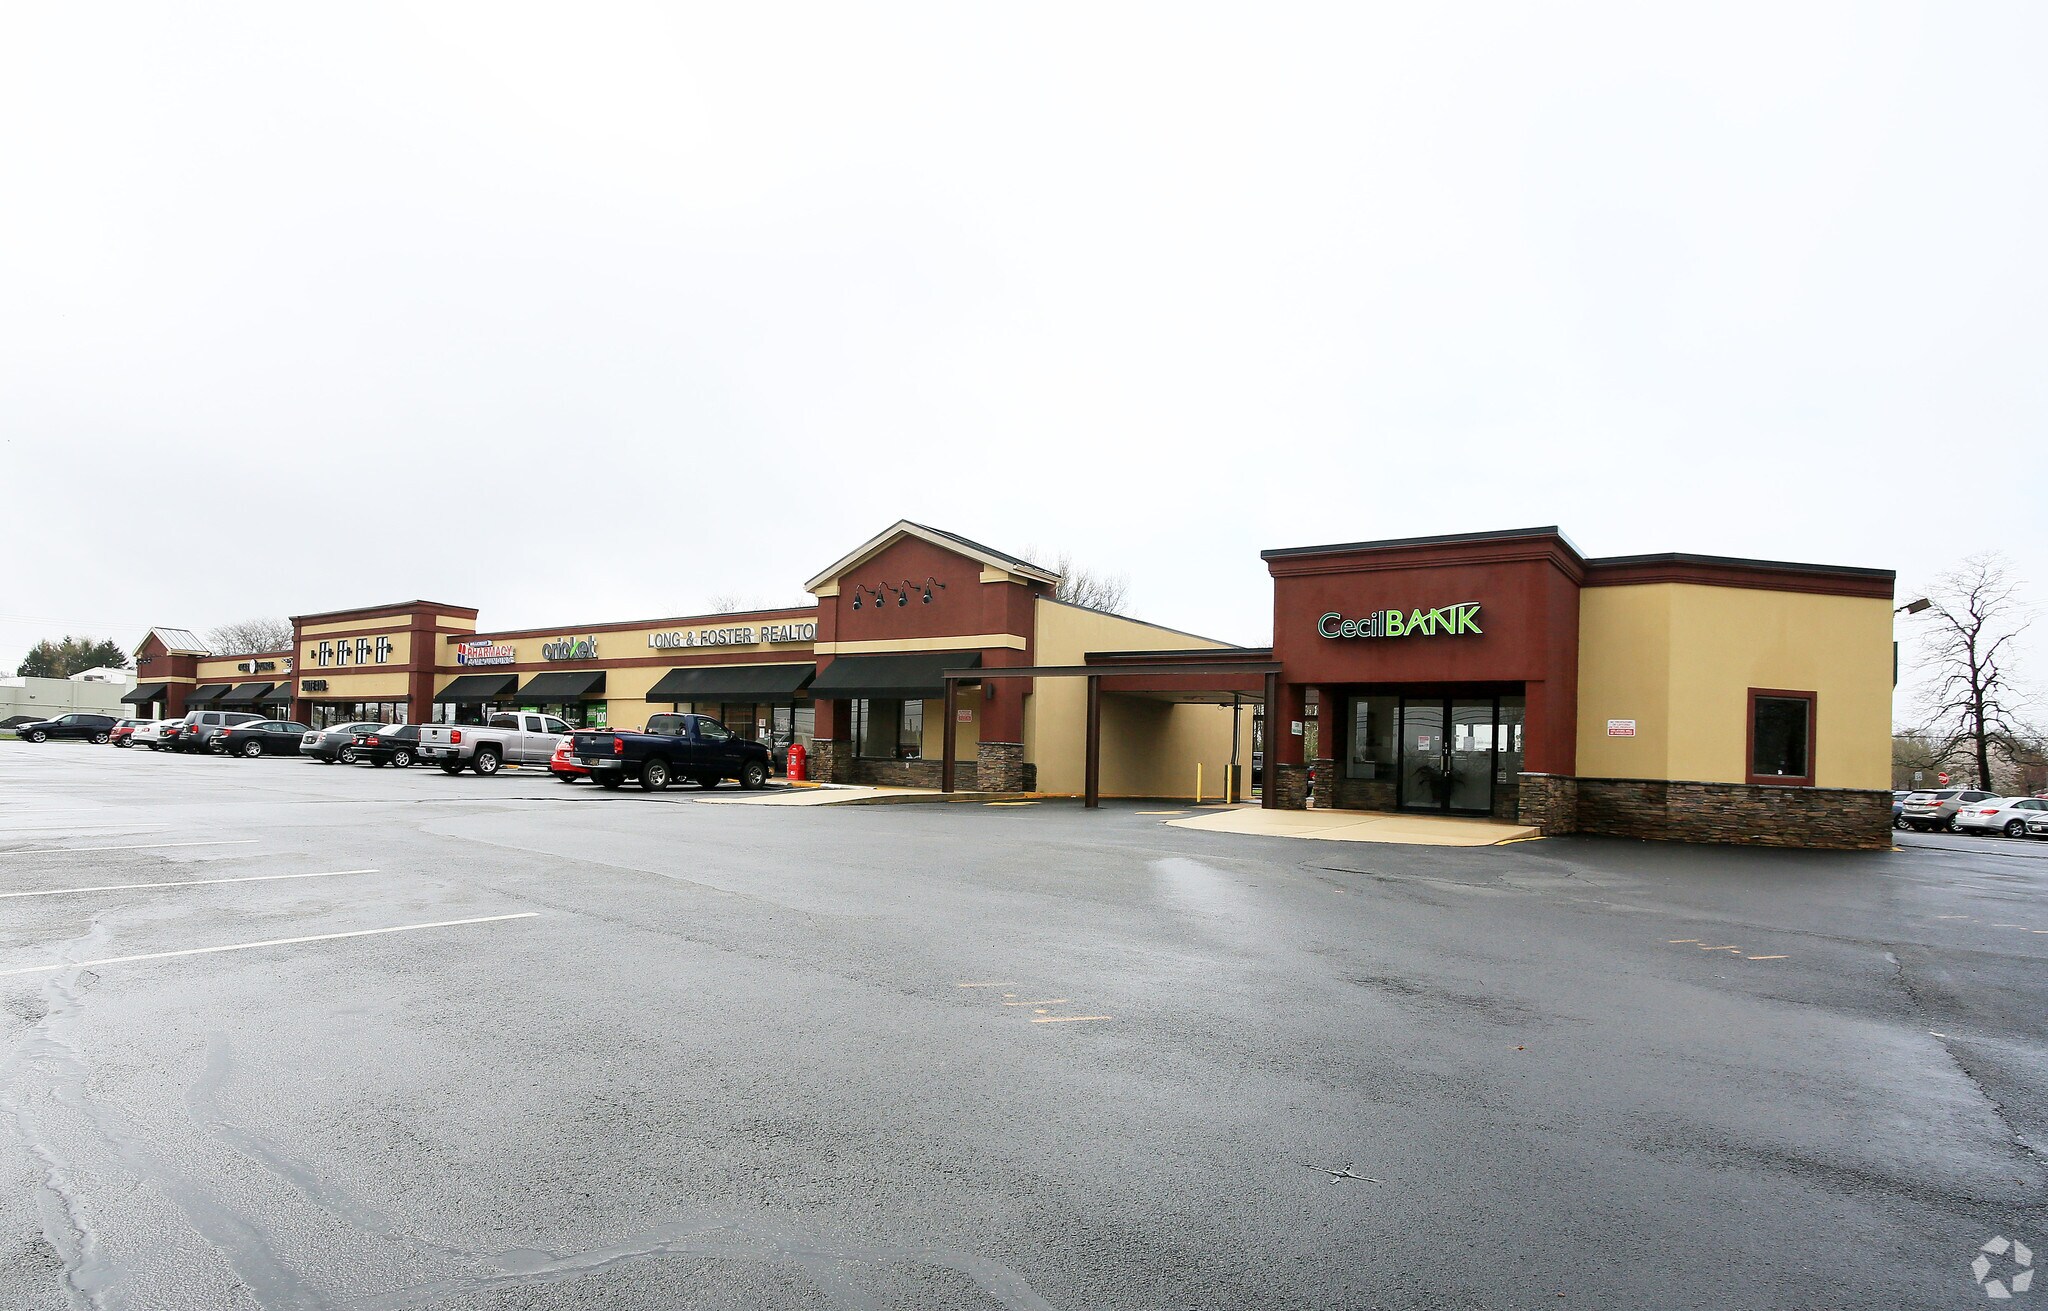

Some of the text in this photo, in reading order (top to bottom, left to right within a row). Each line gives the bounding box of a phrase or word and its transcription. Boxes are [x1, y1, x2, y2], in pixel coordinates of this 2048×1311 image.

[1317, 602, 1483, 639] CecilBANK
[542, 635, 597, 660] cricket
[648, 623, 818, 649] LONG & FOSTER REALTO
[467, 645, 513, 658] PHARMACY
